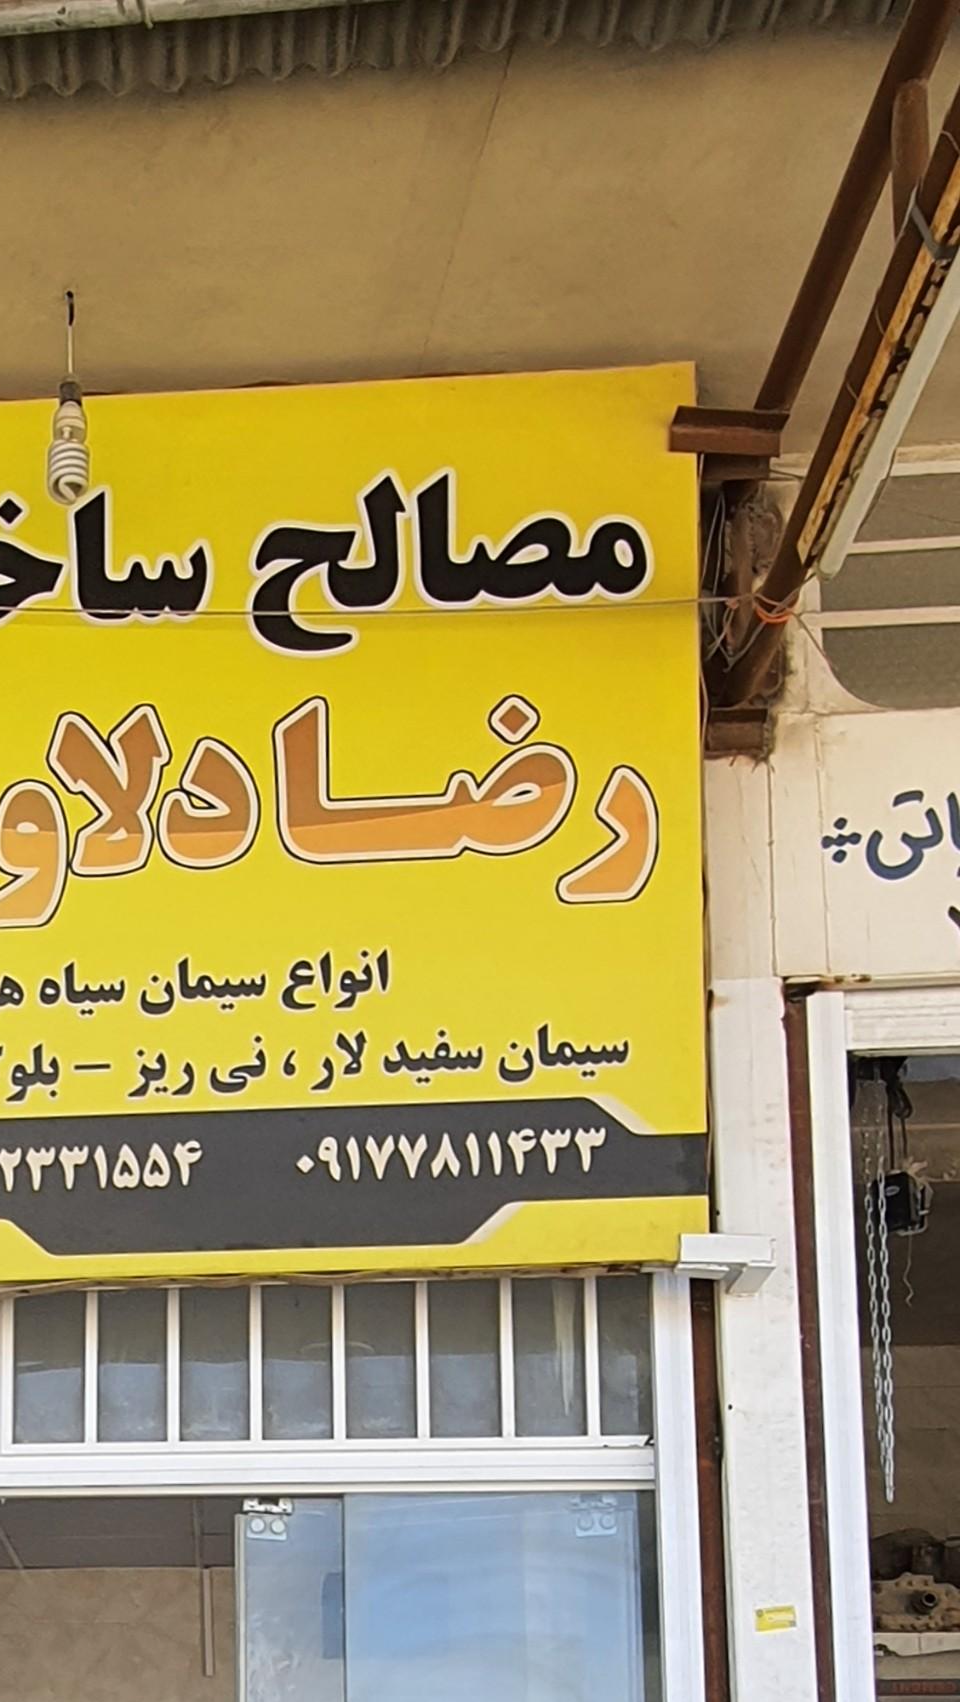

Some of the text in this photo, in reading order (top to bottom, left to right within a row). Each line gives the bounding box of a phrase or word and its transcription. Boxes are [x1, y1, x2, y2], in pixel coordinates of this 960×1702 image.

[249, 472, 649, 654] مصالح
[272, 694, 659, 904] رضا
[40, 962, 125, 1016] سیاه
[140, 957, 267, 1016] سیمان
[281, 949, 390, 1010] انواع
[383, 1029, 483, 1084] سفید
[498, 1023, 629, 1083] سیمان
[296, 1127, 606, 1181] ۰۹۱۷۷۸۱۱۴۳۳
